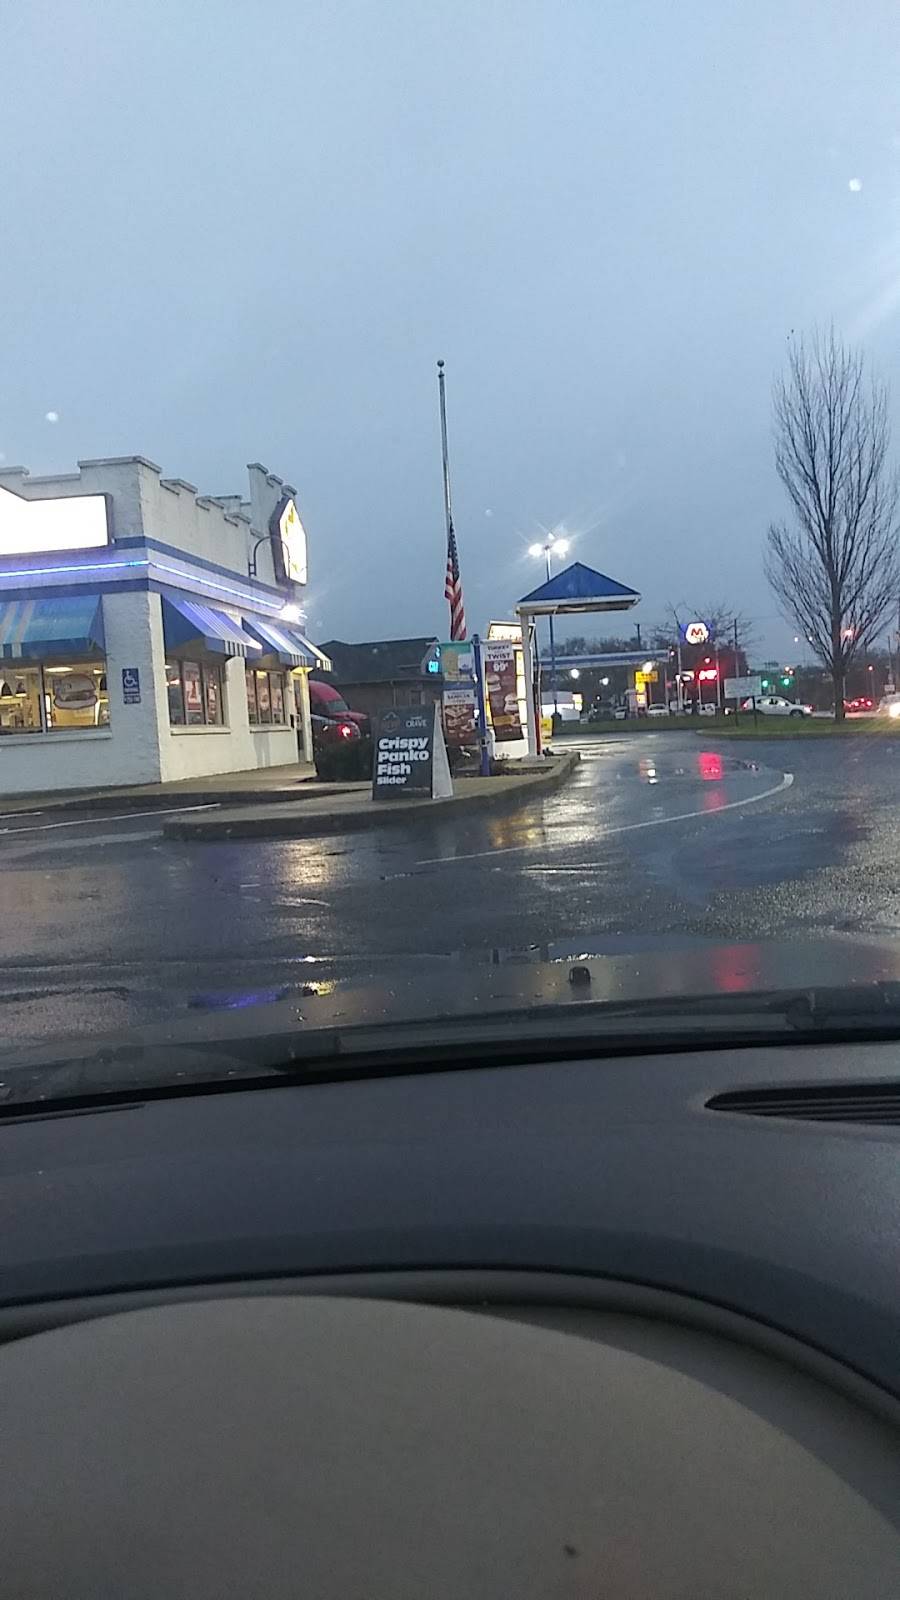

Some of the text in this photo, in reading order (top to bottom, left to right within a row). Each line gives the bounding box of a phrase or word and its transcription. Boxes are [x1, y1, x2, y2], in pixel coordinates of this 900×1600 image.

[378, 736, 429, 750] Crispy
[377, 749, 430, 762] Panko
[377, 762, 411, 775] Fish
